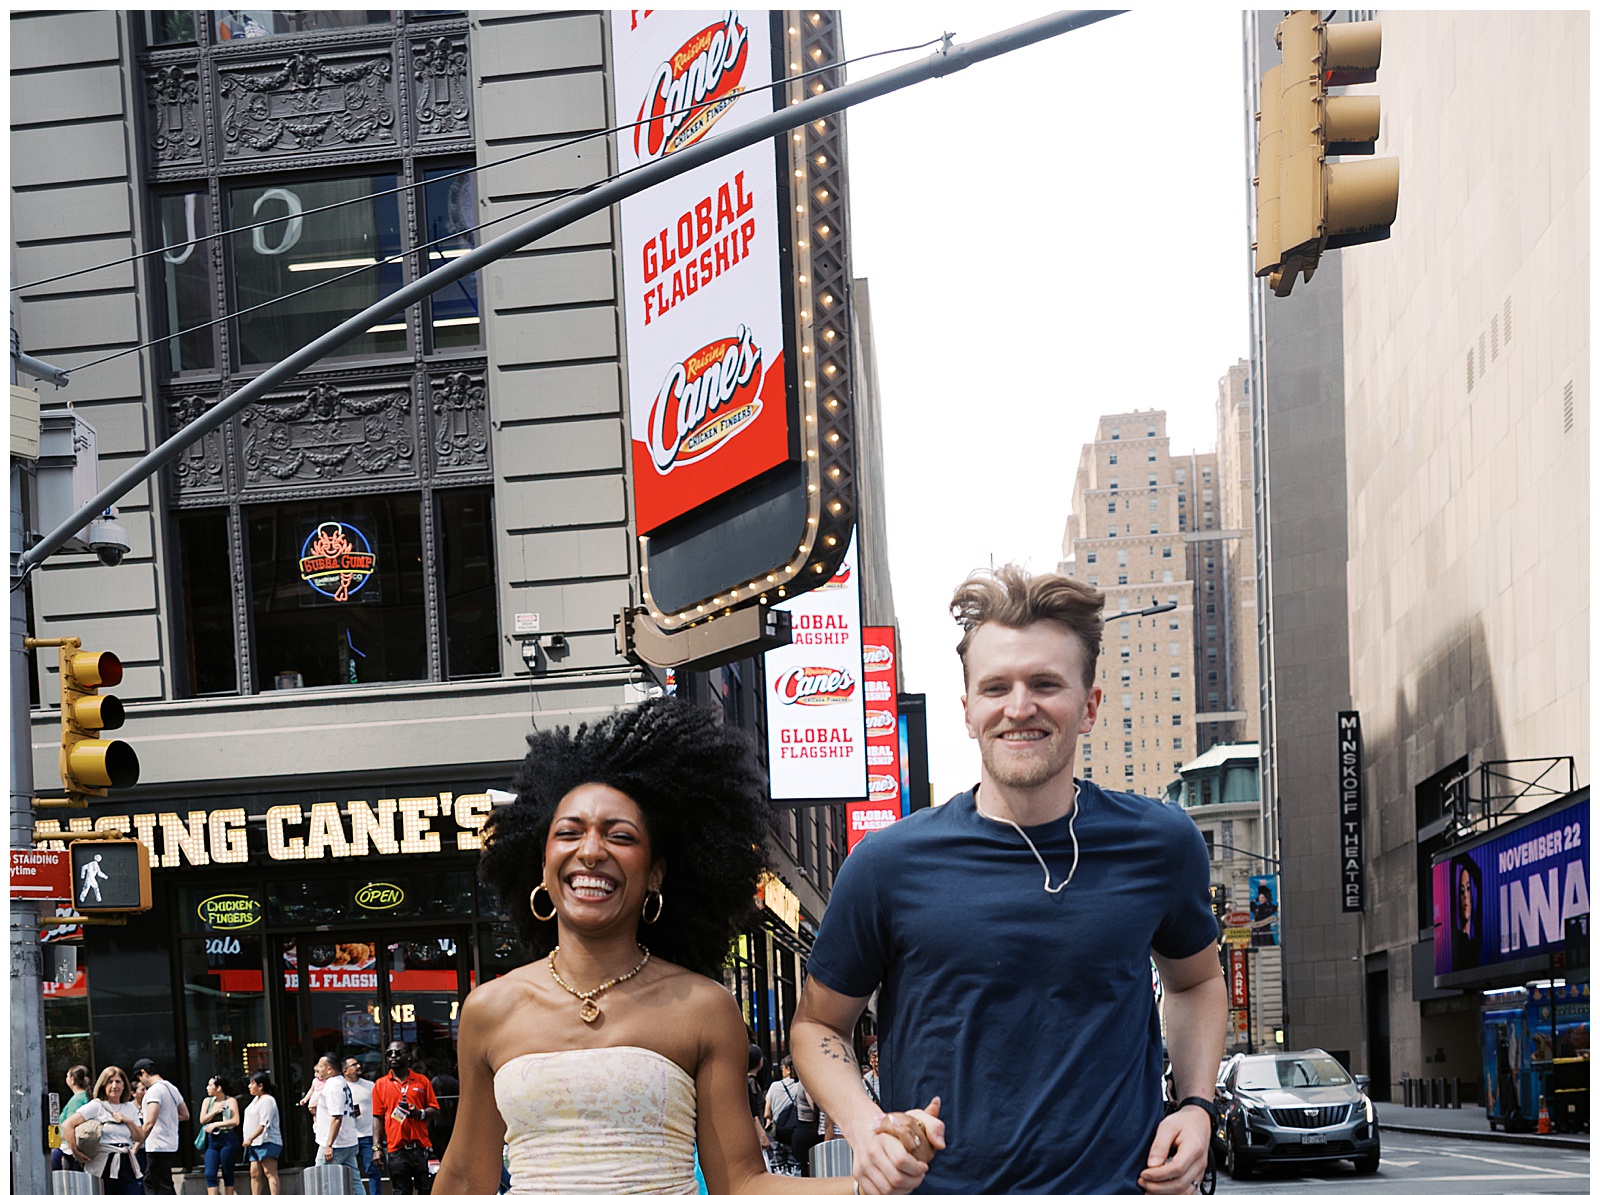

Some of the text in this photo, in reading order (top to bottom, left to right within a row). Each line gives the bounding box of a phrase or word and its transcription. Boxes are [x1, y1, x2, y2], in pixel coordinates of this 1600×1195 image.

[672, 31, 712, 77] Raising
[674, 118, 704, 148] CHICKEN
[643, 170, 753, 284] GLOBAL
[643, 217, 755, 326] FLAGSHIP
[687, 343, 726, 379] Raising
[651, 323, 761, 470] Cane's
[688, 405, 752, 450] CHICKEN FINGERS
[303, 555, 373, 573] BUBBA GUMP
[777, 666, 855, 705] Cane's
[781, 728, 853, 743] GLOBAL
[781, 746, 854, 759] FLAGSHIP
[1341, 717, 1358, 815] MINSKOFF
[266, 791, 492, 860] CANE'S
[852, 810, 896, 821] GLOBAL
[13, 854, 59, 865] STANDING
[1345, 822, 1360, 907] THEATRE
[1499, 822, 1582, 874] NOVEMBER 22
[207, 900, 253, 911] CHICKEN
[359, 889, 399, 902] OPEN
[208, 911, 253, 924] FINGERS
[1235, 963, 1244, 996] PARK
